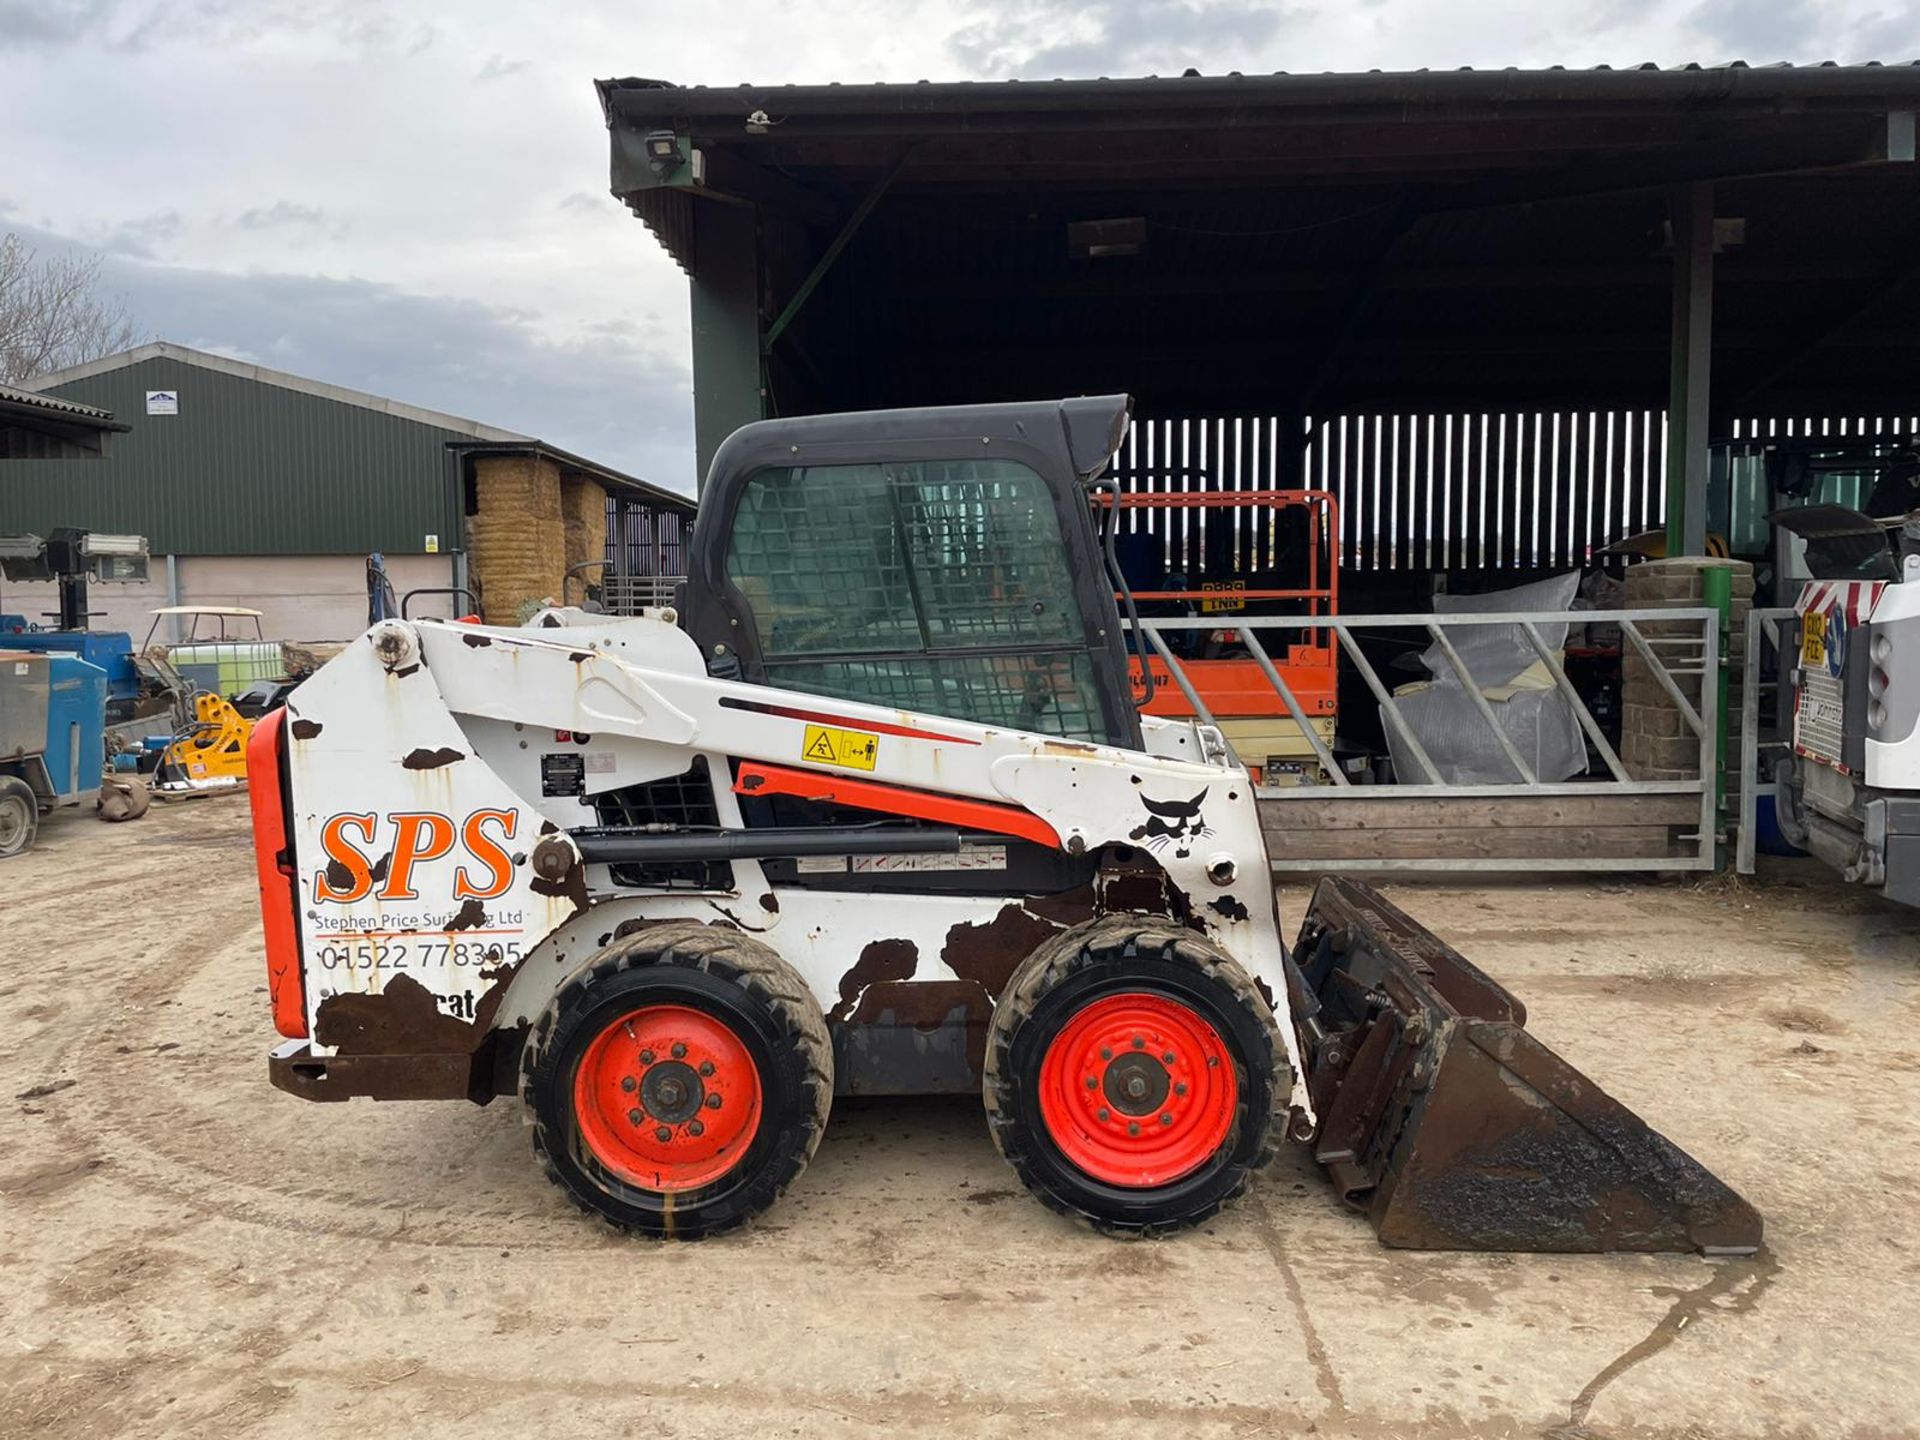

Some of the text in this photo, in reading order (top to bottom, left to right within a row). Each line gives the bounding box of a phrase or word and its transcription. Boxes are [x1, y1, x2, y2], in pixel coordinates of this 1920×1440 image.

[313, 808, 519, 904] SPS
[315, 915, 377, 931] Stephen
[382, 912, 419, 927] Price
[499, 910, 523, 924] Ltd
[321, 942, 521, 969] 01522 778305
